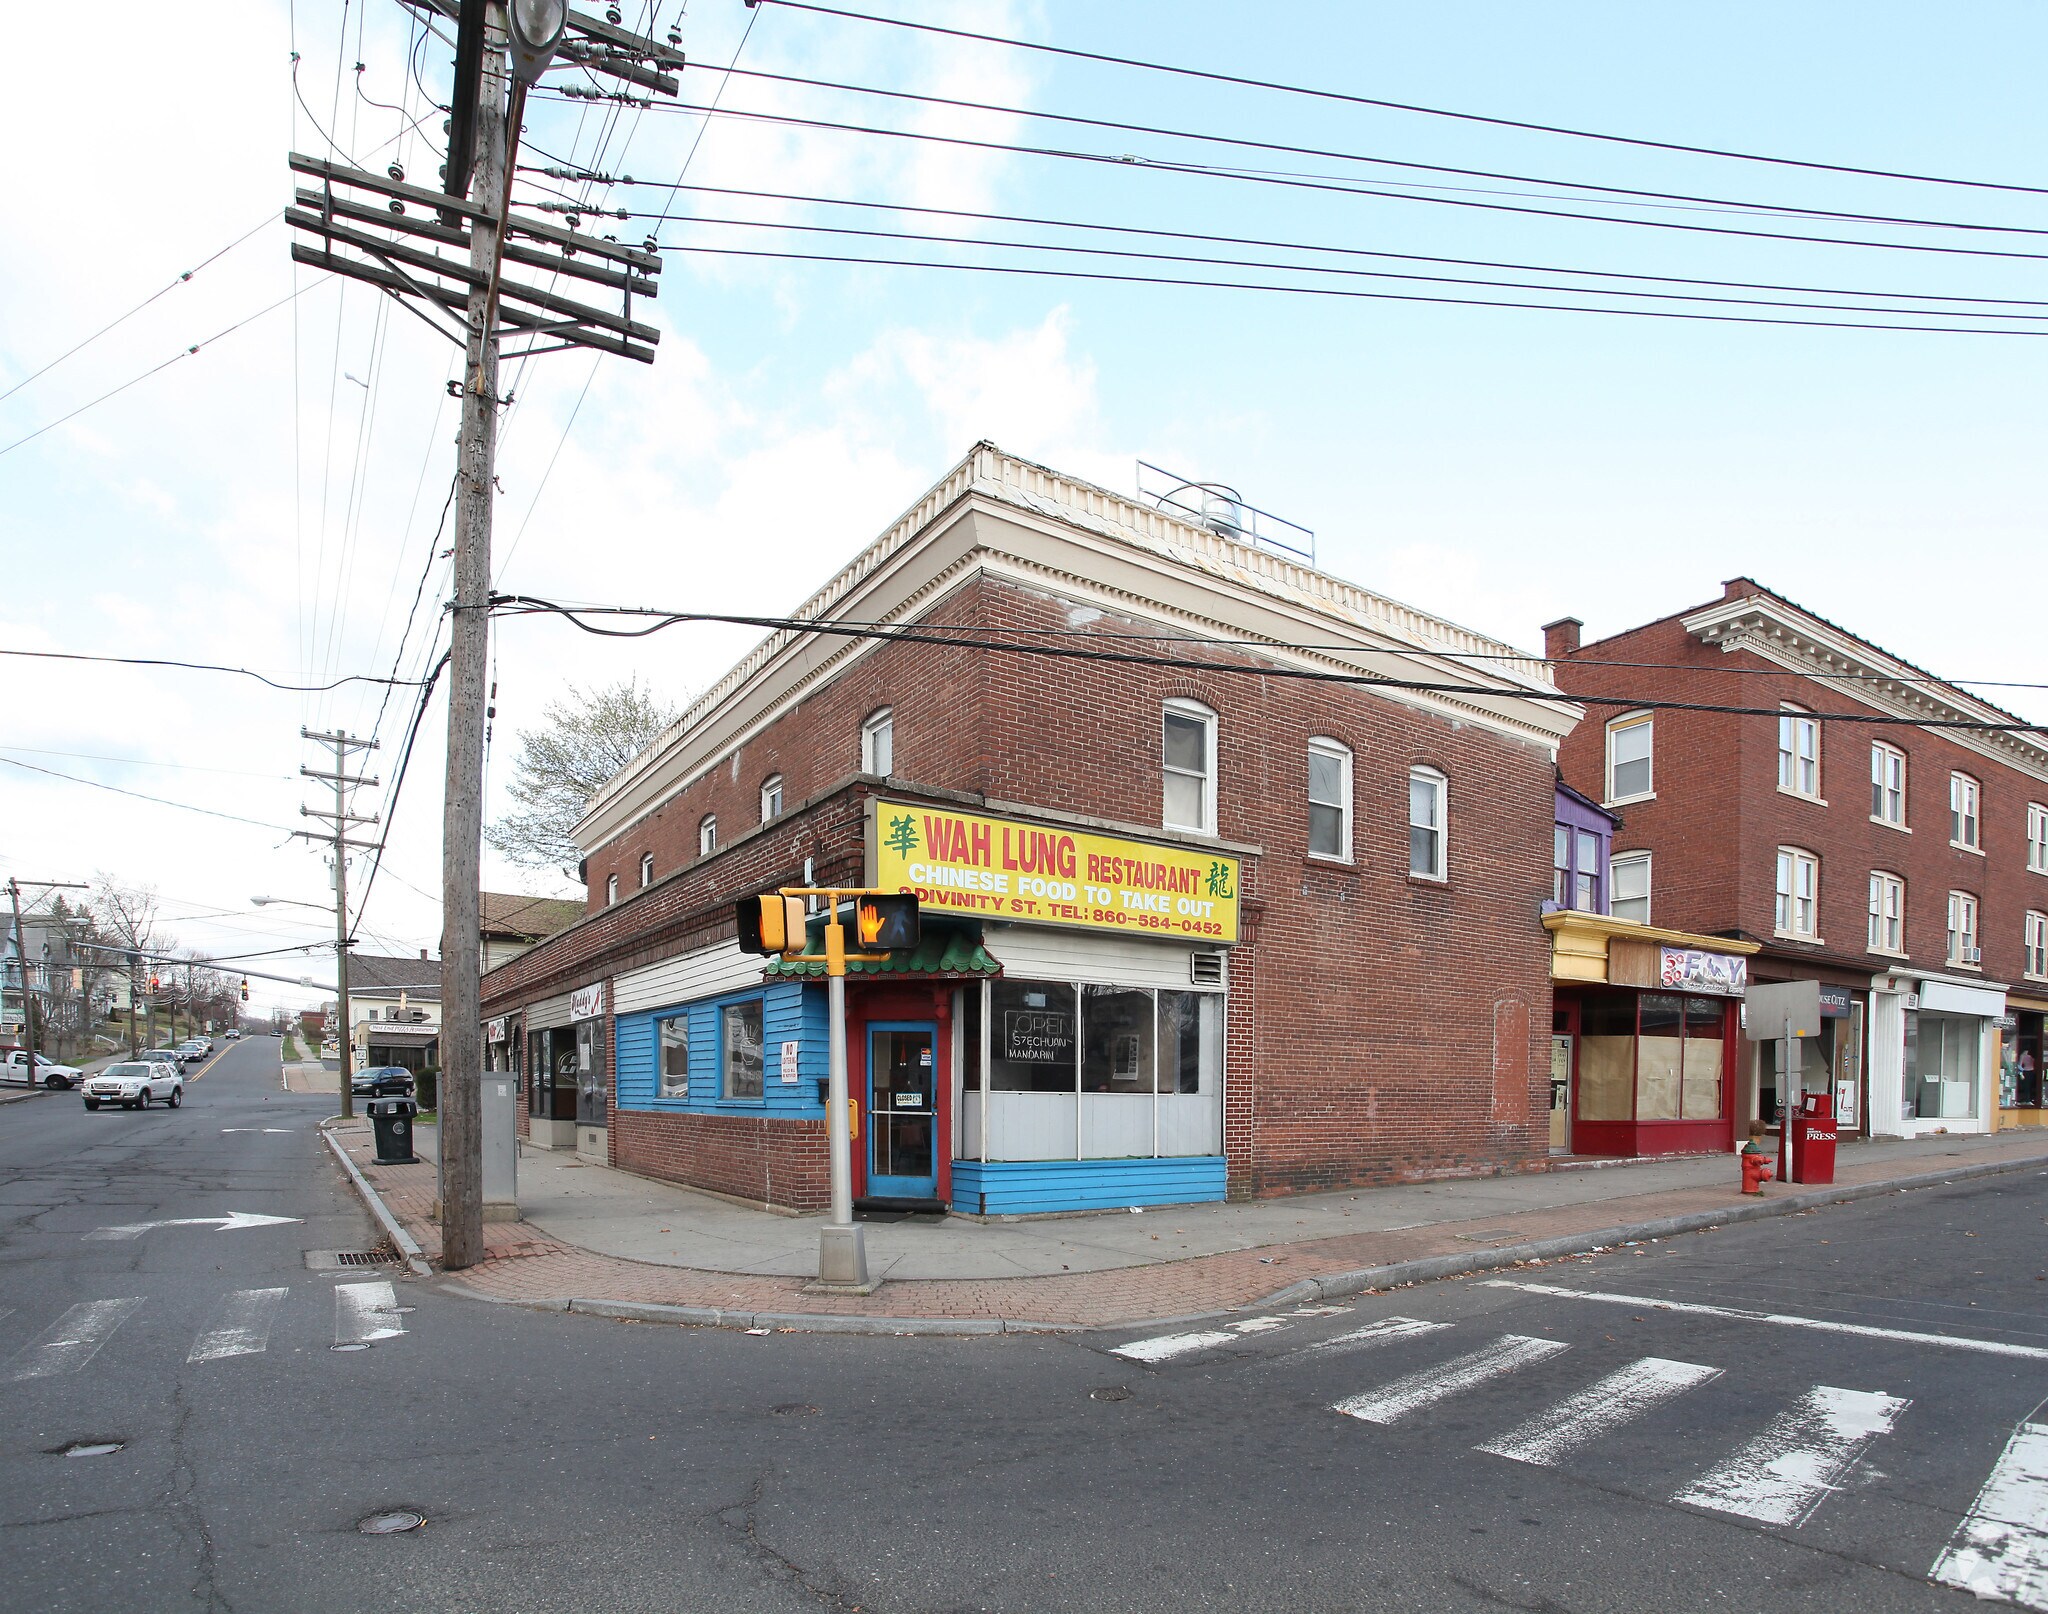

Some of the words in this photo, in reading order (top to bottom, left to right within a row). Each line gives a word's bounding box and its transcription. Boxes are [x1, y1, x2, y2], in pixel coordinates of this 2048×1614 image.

[884, 814, 920, 861] 華
[923, 815, 991, 867] WAH
[1002, 827, 1077, 879] LUNG
[1087, 853, 1201, 895] RESTAURANT
[908, 863, 1008, 893] CHINESE
[1018, 876, 1076, 900] FOOD
[1083, 885, 1111, 906] TO
[1120, 891, 1170, 913] TAKE
[1177, 897, 1214, 918] OUT
[1205, 861, 1233, 899] 龍
[915, 887, 1005, 911] DIVINITY
[1011, 899, 1041, 915] ST.
[1048, 903, 1088, 920] TEL:
[1093, 909, 1222, 935] 860-584-0452
[1013, 1035, 1067, 1047] SZECHUAN
[1016, 1015, 1074, 1035] OPEN
[1009, 1049, 1055, 1061] MANDARIN
[1806, 1132, 1836, 1141] PRESS
